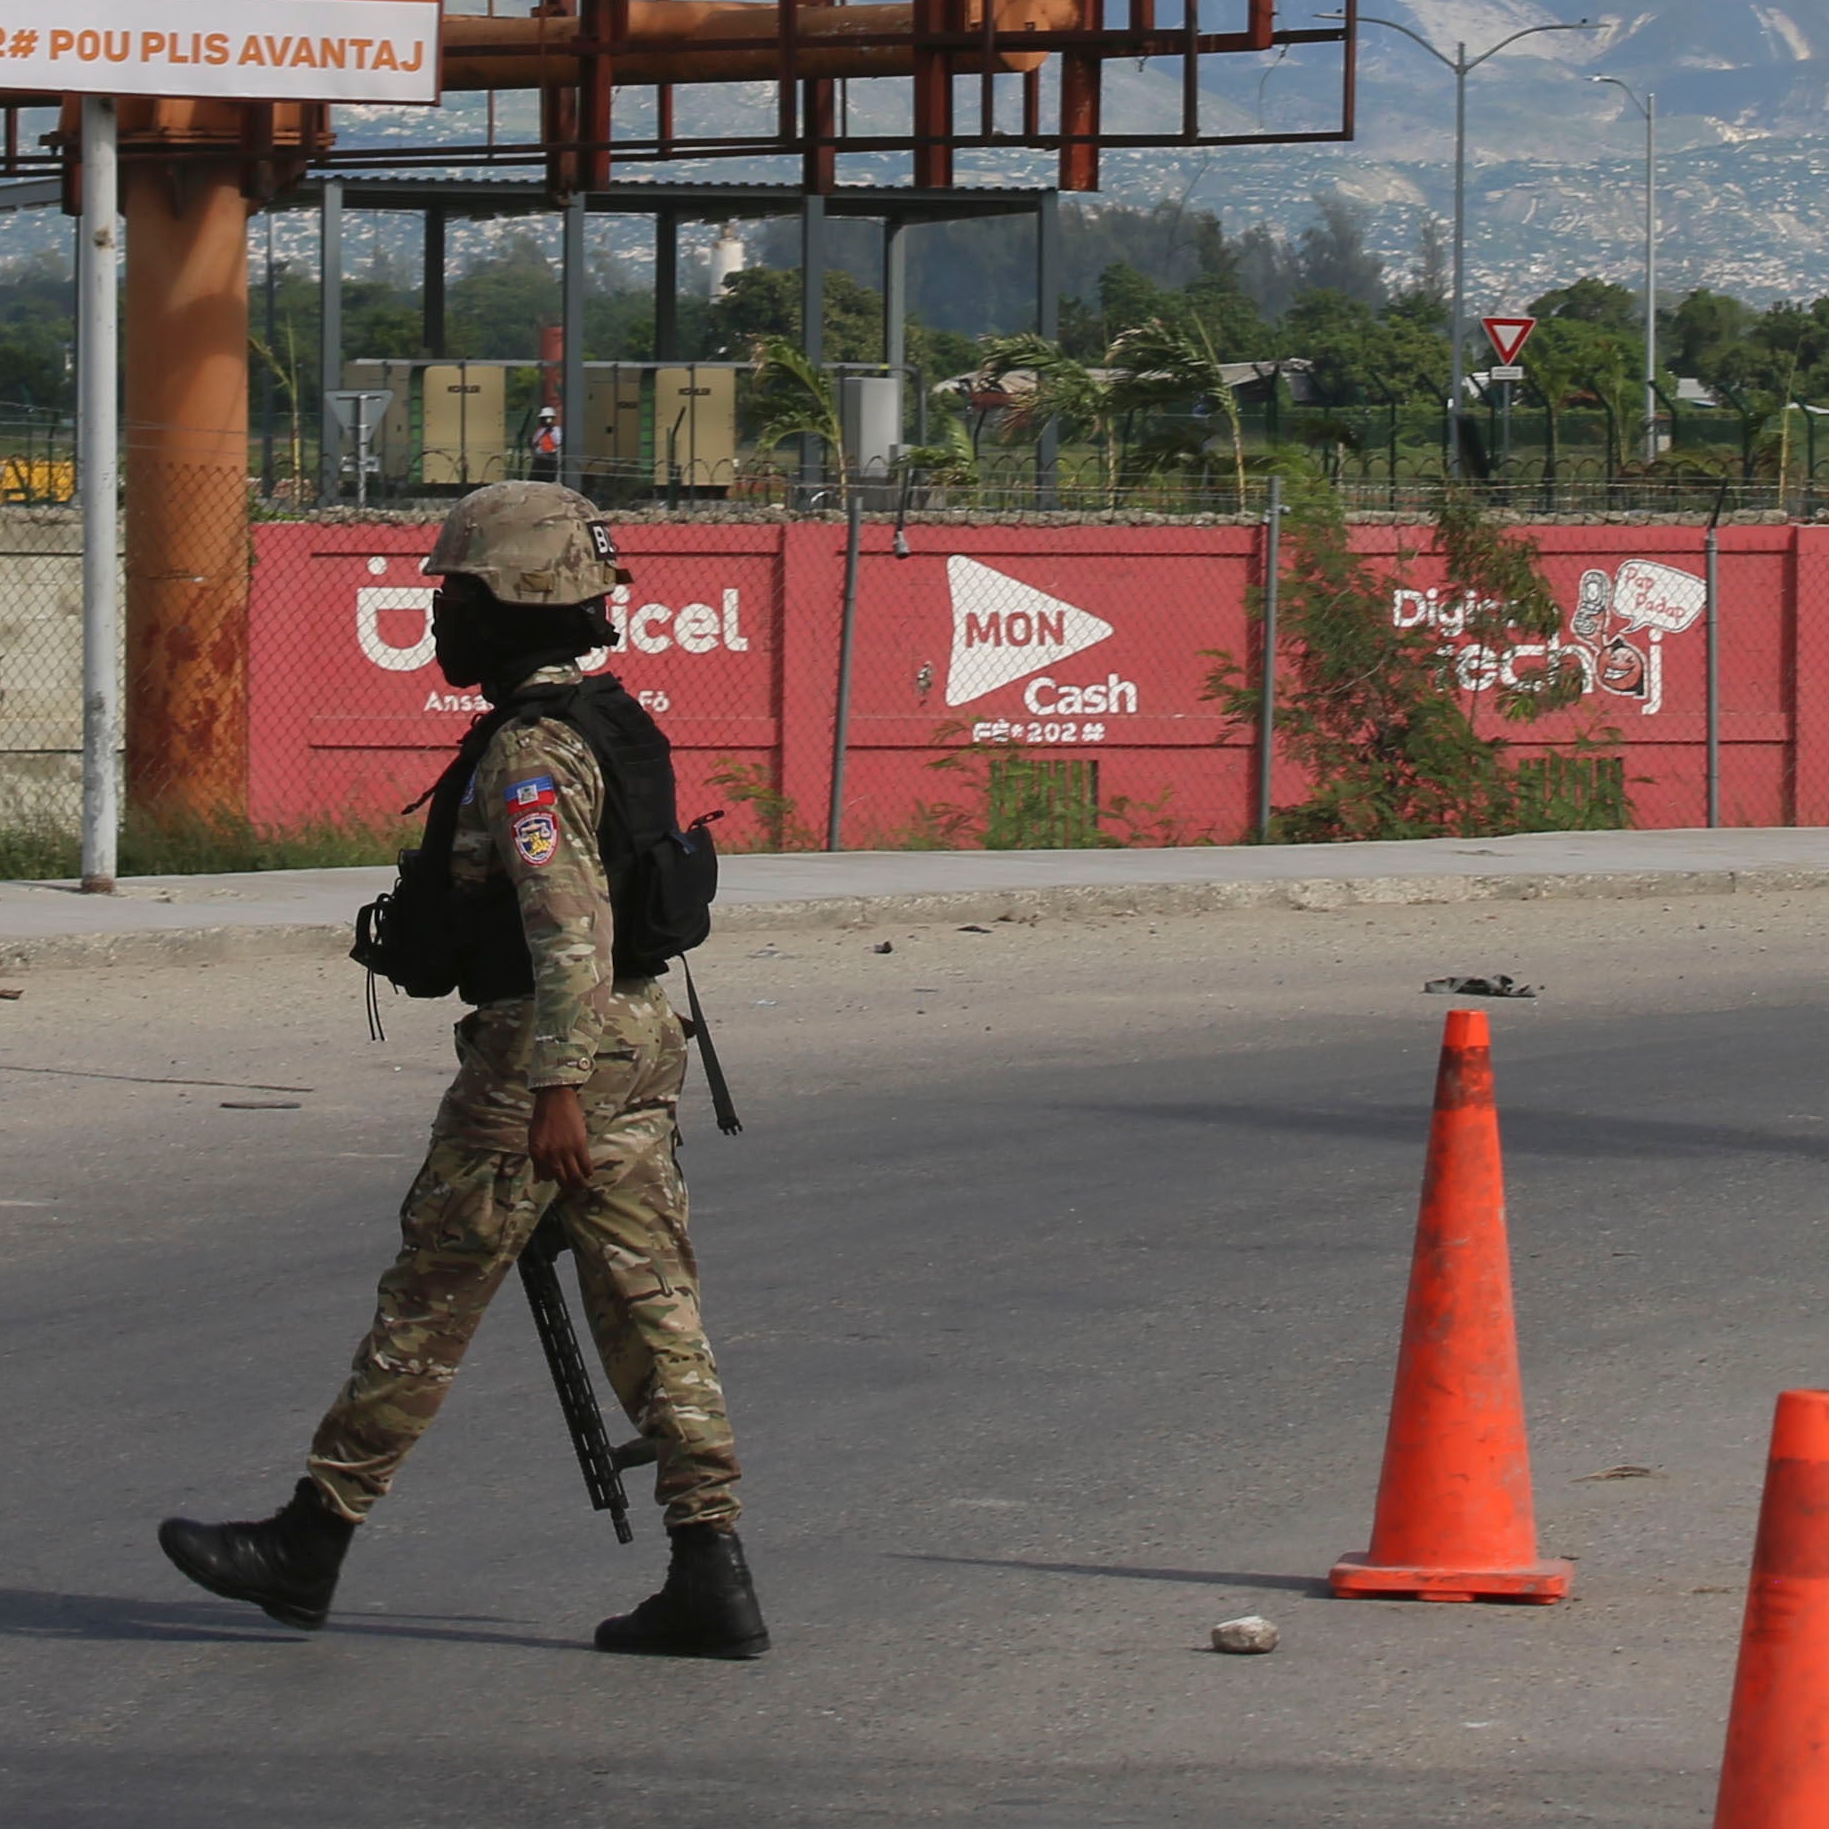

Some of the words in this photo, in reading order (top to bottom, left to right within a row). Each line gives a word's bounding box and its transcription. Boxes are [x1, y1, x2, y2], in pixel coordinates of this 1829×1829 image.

[49, 28, 131, 63] POU
[140, 31, 230, 65] PLIS
[237, 34, 424, 72] AVANTAJ
[575, 585, 749, 672] icel
[965, 610, 1065, 649] MON
[424, 690, 495, 712] Ansa
[1024, 673, 1138, 716] Cash
